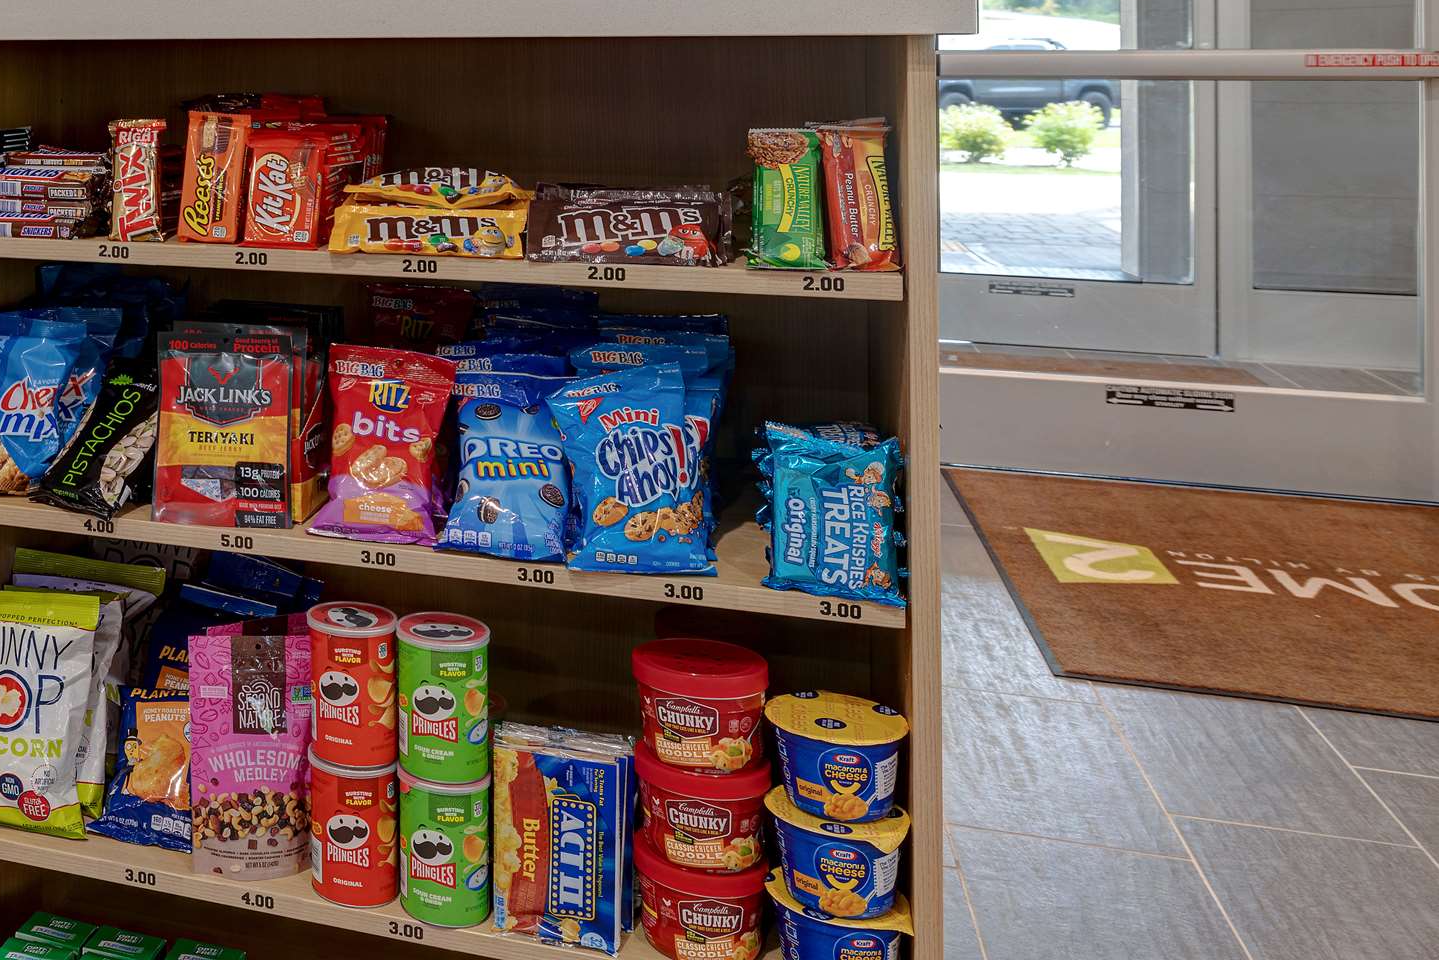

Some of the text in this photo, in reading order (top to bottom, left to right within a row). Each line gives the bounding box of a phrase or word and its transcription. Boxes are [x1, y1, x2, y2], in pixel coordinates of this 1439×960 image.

[118, 131, 158, 143] RIGHT
[784, 177, 796, 217] CRUNCHY
[793, 164, 811, 230] NATURE VALLEY
[844, 172, 860, 238] Peanut Butter
[864, 184, 877, 226] CRUNCHY
[20, 226, 54, 237] SNICKERS
[98, 244, 130, 259] 2.00
[235, 251, 268, 266] 2.00
[401, 258, 438, 274] 2.00
[587, 265, 627, 282] 2.00
[803, 276, 845, 292] 2.00
[168, 340, 189, 350] 100
[233, 342, 280, 353] Protein
[592, 350, 644, 365] BIG BAG
[335, 359, 385, 378] BIG BAG
[176, 386, 272, 406] JACK LINK'S
[368, 380, 412, 409] RITZ
[476, 383, 502, 398] BAG
[351, 410, 422, 444] bits
[598, 406, 660, 432] Mini
[62, 388, 142, 487] PISTACHIOS
[188, 430, 255, 446] TERIYAKI
[461, 437, 563, 466] OREO
[240, 466, 260, 480] 13g
[476, 458, 551, 478] mini
[239, 487, 281, 499] 100 CALORIES
[358, 501, 393, 514] cheese
[83, 518, 115, 534] 4.00
[255, 515, 265, 525] FAT
[265, 515, 277, 526] FREE
[220, 533, 253, 550] 5.00
[821, 486, 851, 586] TREATS
[848, 484, 870, 590] RICE KRISPIES
[360, 550, 396, 566] 3.00
[517, 567, 555, 585] 3.00
[664, 583, 704, 601] 3.00
[1175, 559, 1439, 612] OME
[819, 600, 862, 620] 3.00
[334, 655, 362, 665] FLAVOR
[439, 670, 466, 678] FLAVOR
[319, 698, 360, 726] PRINGLES
[665, 699, 702, 714] Campbell's
[143, 712, 187, 723] PEANUTS
[238, 709, 282, 730] NATURE
[657, 705, 715, 731] CHUNKY
[412, 713, 457, 741] PRINGLES
[324, 734, 353, 746] ORIGINAL
[656, 739, 682, 751] CLASSIC
[657, 747, 712, 758] NOODLE
[838, 755, 856, 763] Kraft
[233, 767, 289, 784] MEDLEY
[824, 763, 863, 774] macaroni
[1, 782, 20, 796] GMO
[799, 784, 823, 797] original
[22, 803, 48, 817] FREE
[345, 798, 372, 806] FLAVOR
[678, 802, 715, 816] Campbell's
[436, 815, 465, 823] FLAVOR
[668, 807, 729, 832] CHUNKY
[326, 841, 370, 868] PRINGLES
[522, 817, 541, 883] Butter
[834, 850, 852, 859] Kraft
[559, 809, 586, 908] ACT II
[820, 857, 860, 870] macaroni
[124, 869, 156, 886] 3.00
[411, 856, 455, 886] PRINGLES
[332, 877, 364, 888] ORIGINAL
[795, 875, 819, 891] original
[240, 891, 275, 909] 4.00
[693, 903, 729, 915] Campbell's
[681, 908, 741, 930] CHUNKY
[388, 921, 424, 940] 3.00
